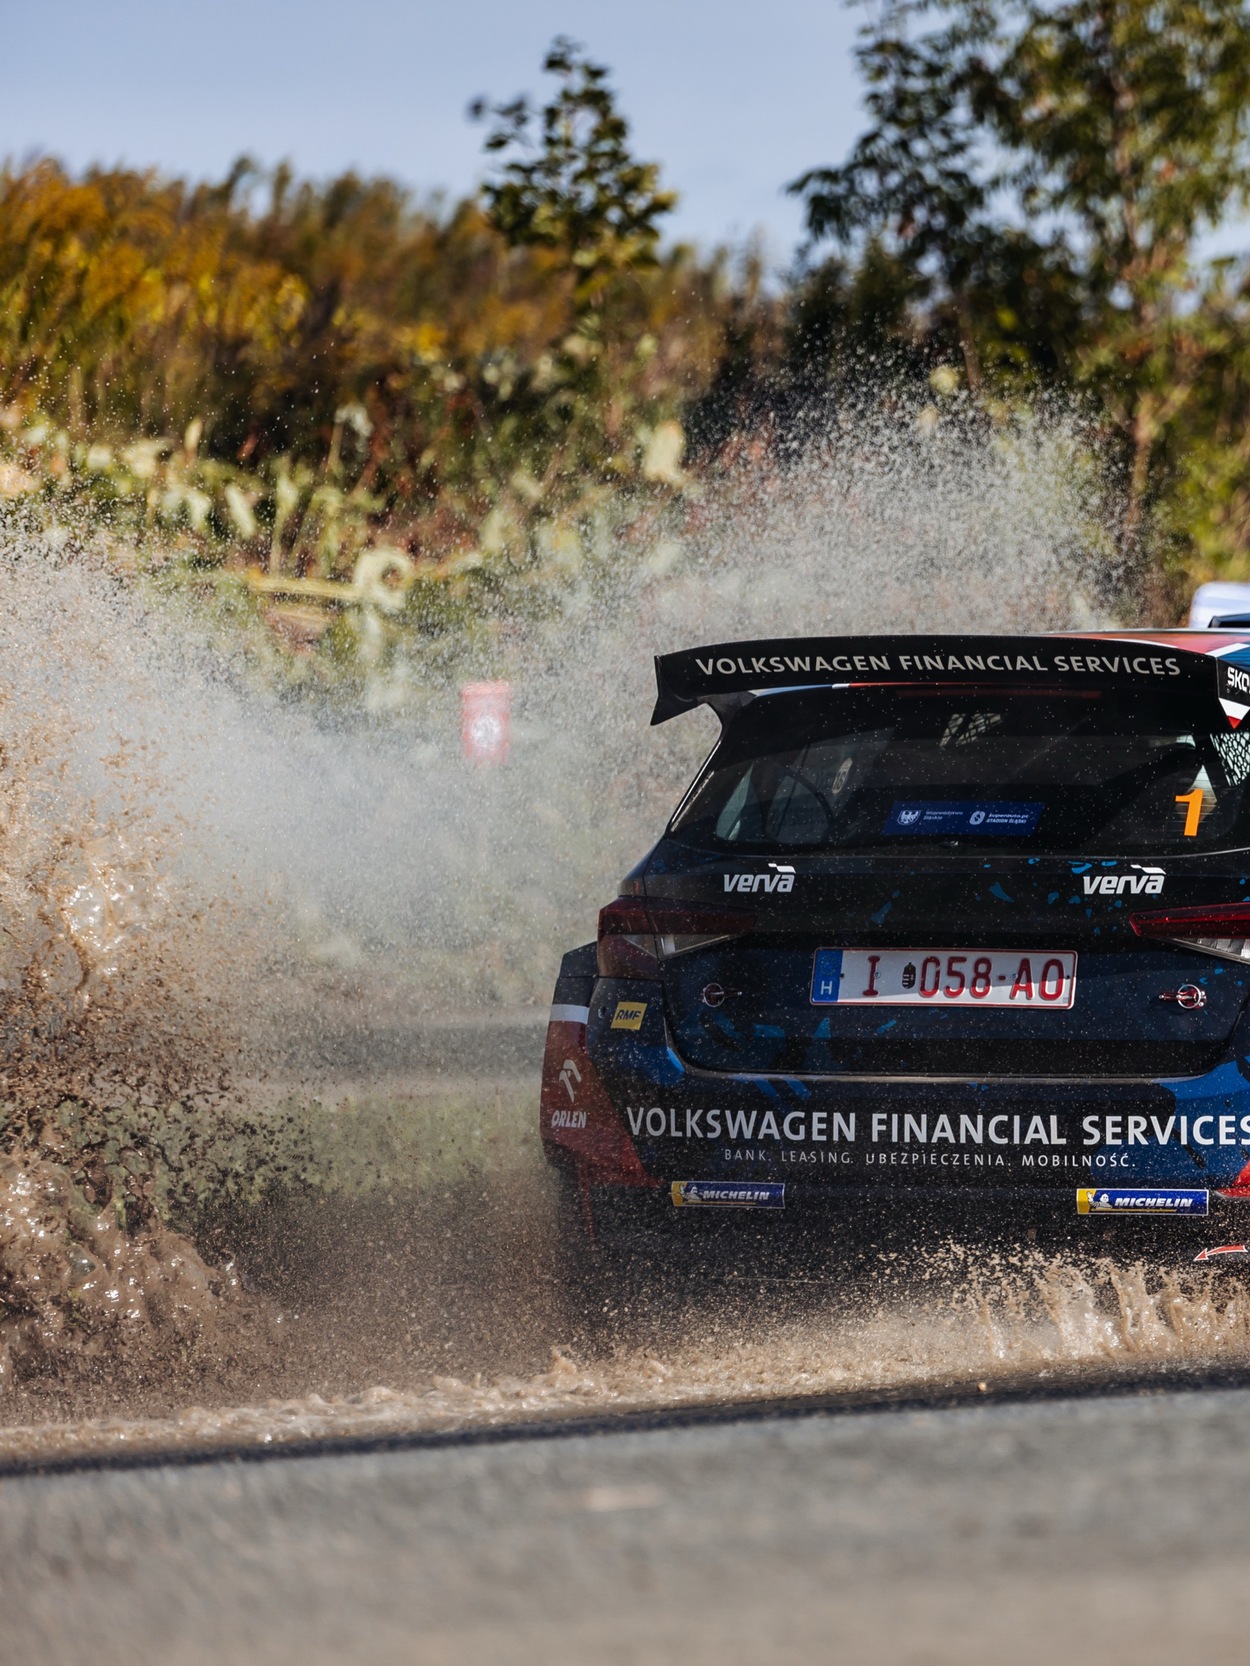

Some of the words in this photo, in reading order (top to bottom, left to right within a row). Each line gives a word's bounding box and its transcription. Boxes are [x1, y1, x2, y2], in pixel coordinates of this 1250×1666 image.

[695, 655, 891, 675] VOLKSWAGEN
[898, 655, 1048, 671] FINANCIAL
[1054, 656, 1180, 675] SERVICES
[1175, 788, 1204, 836] 1
[723, 873, 795, 892] verva
[1083, 874, 1165, 894] verva
[863, 955, 881, 996] I
[820, 980, 833, 995] H
[615, 1009, 641, 1021] RMF
[551, 1109, 587, 1128] ORLEN
[627, 1106, 856, 1142] VOLKSWAGEN
[871, 1112, 1066, 1145] FINANCIAL
[724, 1149, 771, 1161] BANK.
[781, 1150, 854, 1164] LEASING.
[865, 1152, 1011, 1166] UBEZPIECZENIA.
[1022, 1151, 1136, 1168] MOBILNOŚĆ.
[702, 1190, 770, 1200] MICHELIN
[1114, 1197, 1193, 1208] MICHELIN
